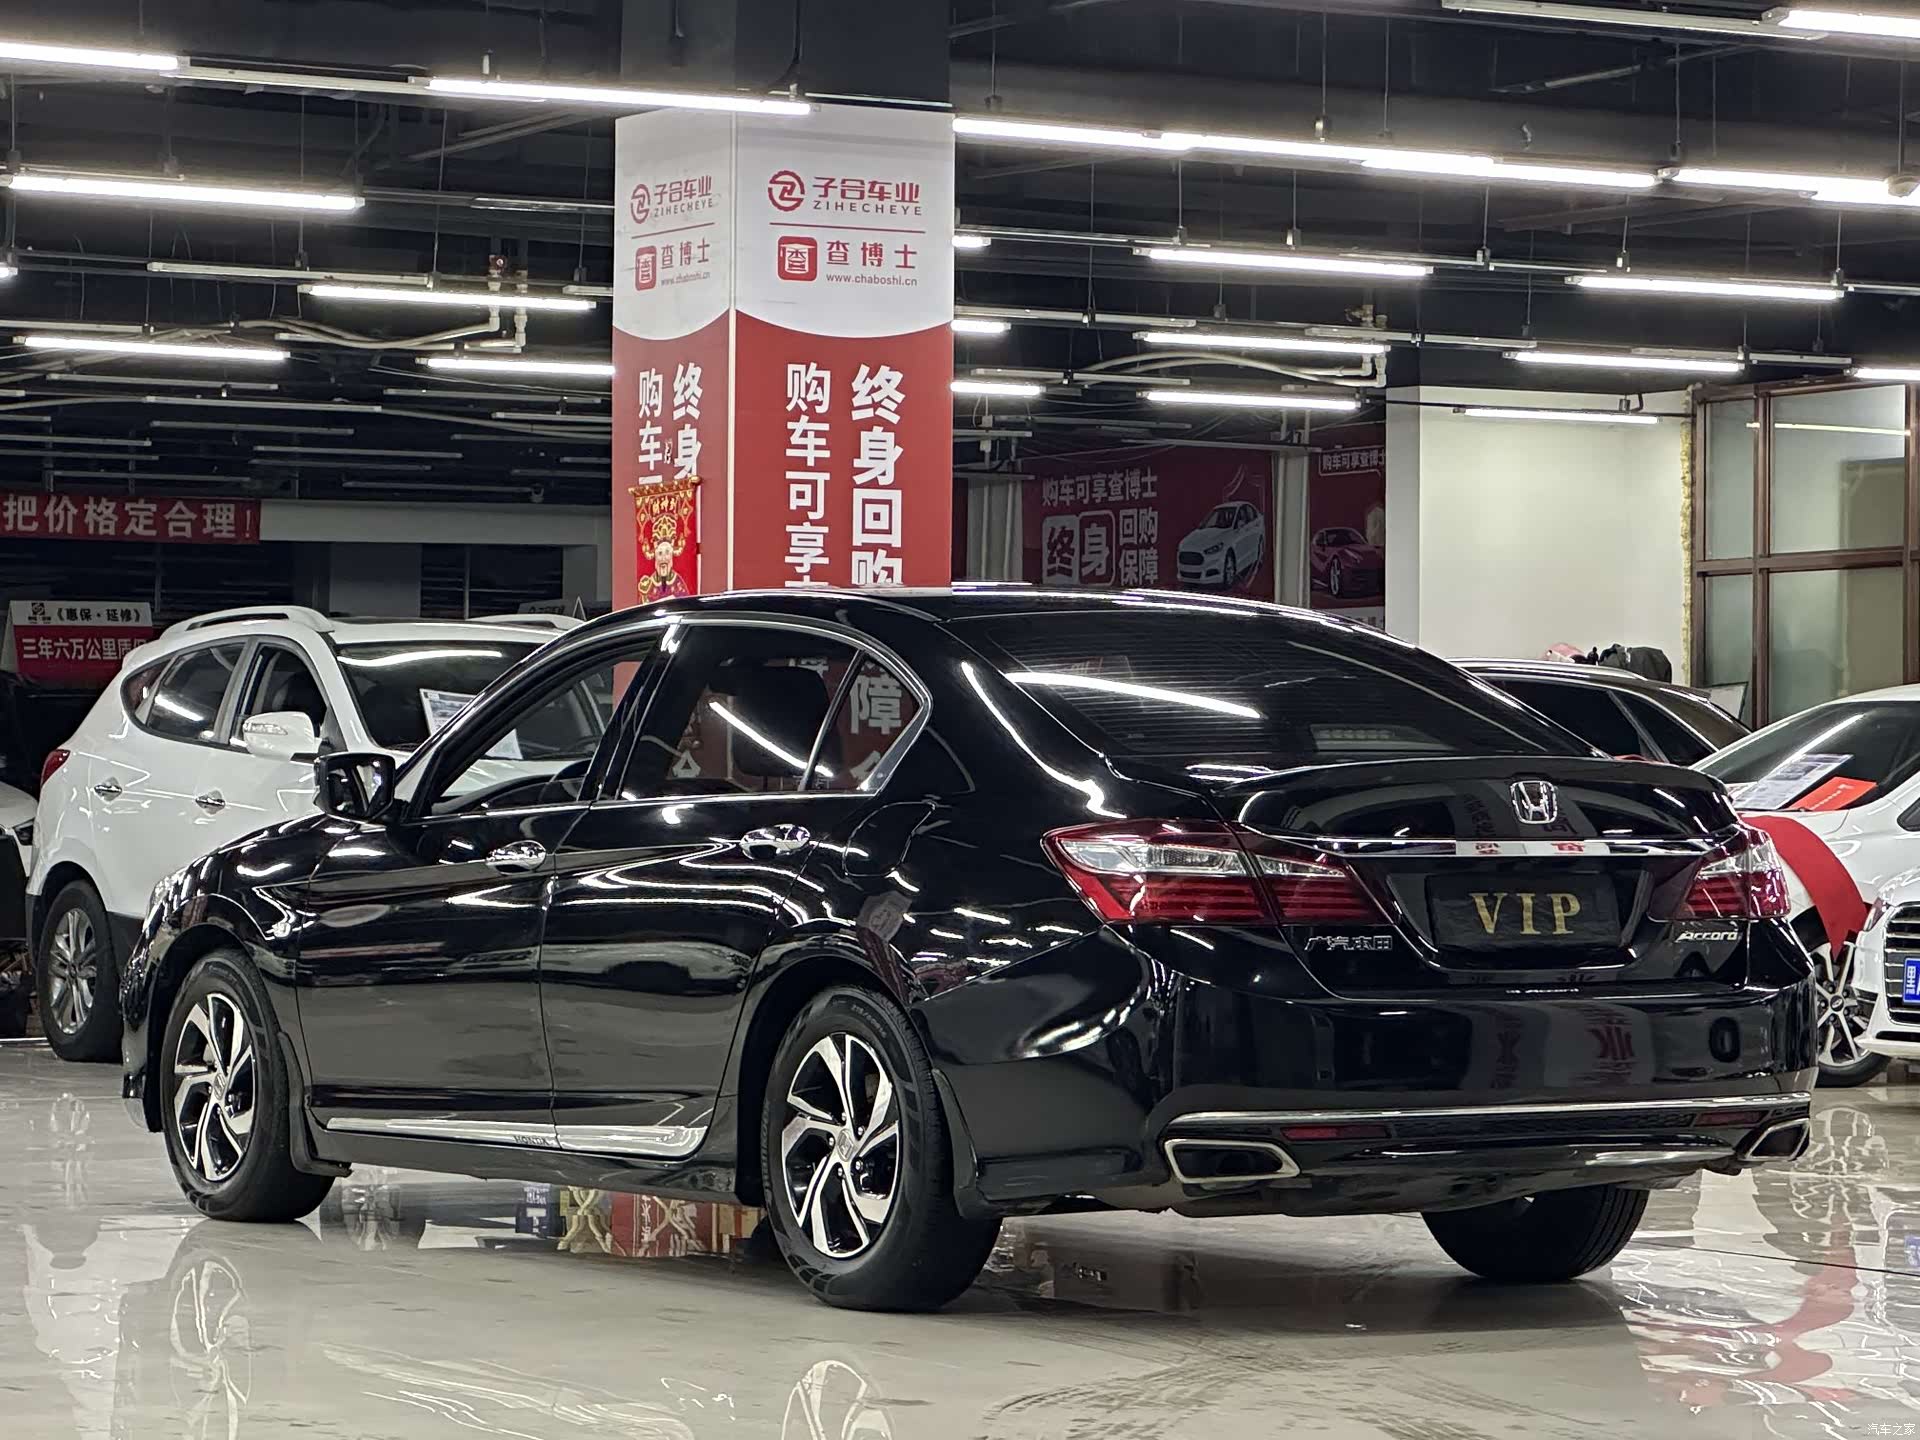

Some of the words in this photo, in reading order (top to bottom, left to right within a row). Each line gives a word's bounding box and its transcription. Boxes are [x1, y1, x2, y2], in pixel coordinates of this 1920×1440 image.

[654, 176, 712, 205] 子合车业
[812, 176, 920, 204] 子合车业
[654, 198, 713, 218] ZIHECHEYE
[813, 200, 922, 216] ZIHECHEYE
[661, 237, 711, 269] 查博士
[826, 240, 918, 269] 查博士
[826, 273, 918, 287] www.chaboshi.cn
[673, 362, 703, 480] 终身
[851, 364, 906, 587] 终身回购
[1041, 466, 1159, 508] 购车可享查博士
[1119, 506, 1159, 547] 回购
[1046, 522, 1110, 578] 终身
[1118, 547, 1159, 587] 保障
[1469, 891, 1582, 936] VIP
[1304, 935, 1393, 951] 广汽本田
